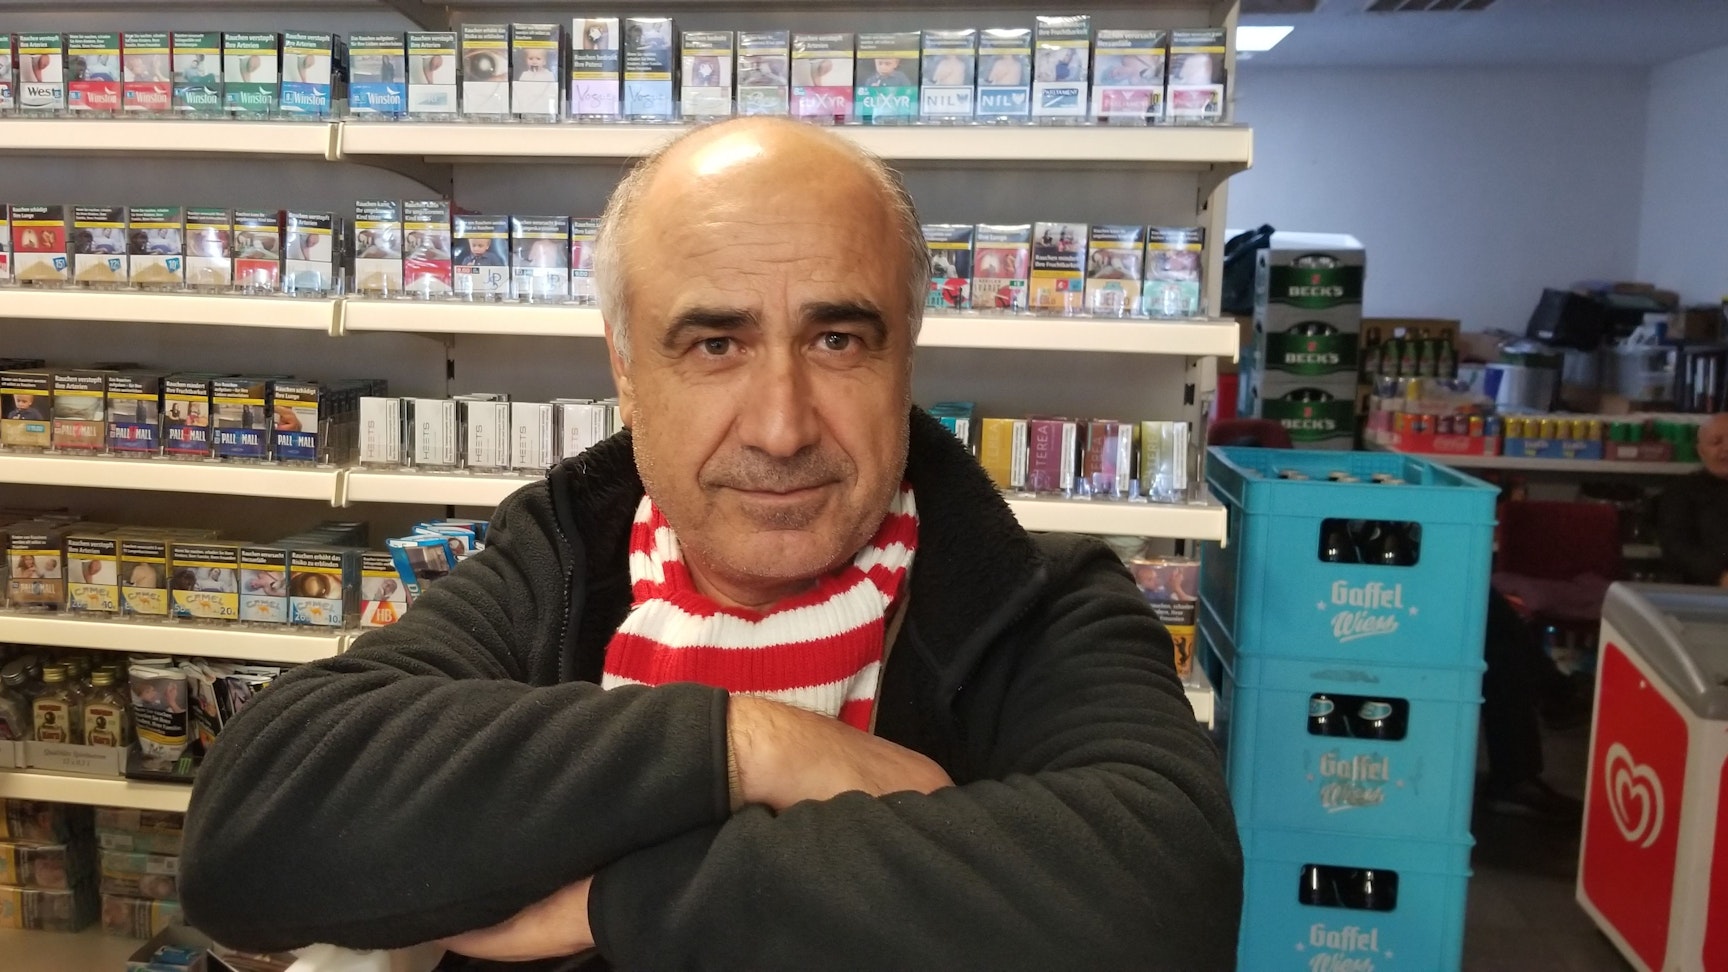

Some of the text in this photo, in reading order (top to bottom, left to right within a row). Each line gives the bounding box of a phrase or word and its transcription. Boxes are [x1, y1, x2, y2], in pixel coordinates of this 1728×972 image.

[87, 92, 116, 103] Winston
[136, 92, 167, 102] Winston
[186, 92, 217, 104] Winston
[240, 92, 272, 104] Winston
[294, 92, 326, 105] Winston
[368, 92, 401, 105] Winston
[576, 84, 614, 108] Vogue
[628, 84, 666, 108] Vogue
[800, 94, 845, 108] ELIXYR
[863, 94, 910, 108] ELIXYR
[928, 96, 955, 106] NIL
[982, 95, 1012, 106] NIL
[309, 214, 330, 222] verstopft
[1289, 286, 1344, 297] BECK'S
[1285, 352, 1340, 364] BECK'S
[78, 376, 102, 385] verstopft
[176, 388, 207, 396] Fruchtbarkeit
[1282, 418, 1336, 430] BECK'S
[62, 424, 96, 437] PALL MALL
[116, 427, 152, 440] PALL MALL
[170, 428, 206, 442] PALL MALL
[222, 433, 258, 446] PALL MALL
[278, 434, 315, 448] PALL MALL
[476, 424, 484, 462] HEETS
[1036, 425, 1048, 466] TEREA
[68, 540, 90, 548] Rauchen
[91, 542, 114, 550] verstopft
[74, 586, 112, 598] CAMEL
[128, 592, 162, 602] CAMEL
[1331, 580, 1403, 610] Gaffel
[186, 594, 224, 606] CAMEL
[246, 600, 280, 609] CAMEL
[220, 606, 232, 616] 20
[296, 600, 335, 613] CAMEL
[295, 612, 306, 621] 26
[329, 614, 338, 623] 10
[376, 608, 392, 622] HB
[1331, 611, 1399, 642] Wiess
[1319, 751, 1389, 782] Gaffel
[1309, 923, 1378, 952] Gaffel
